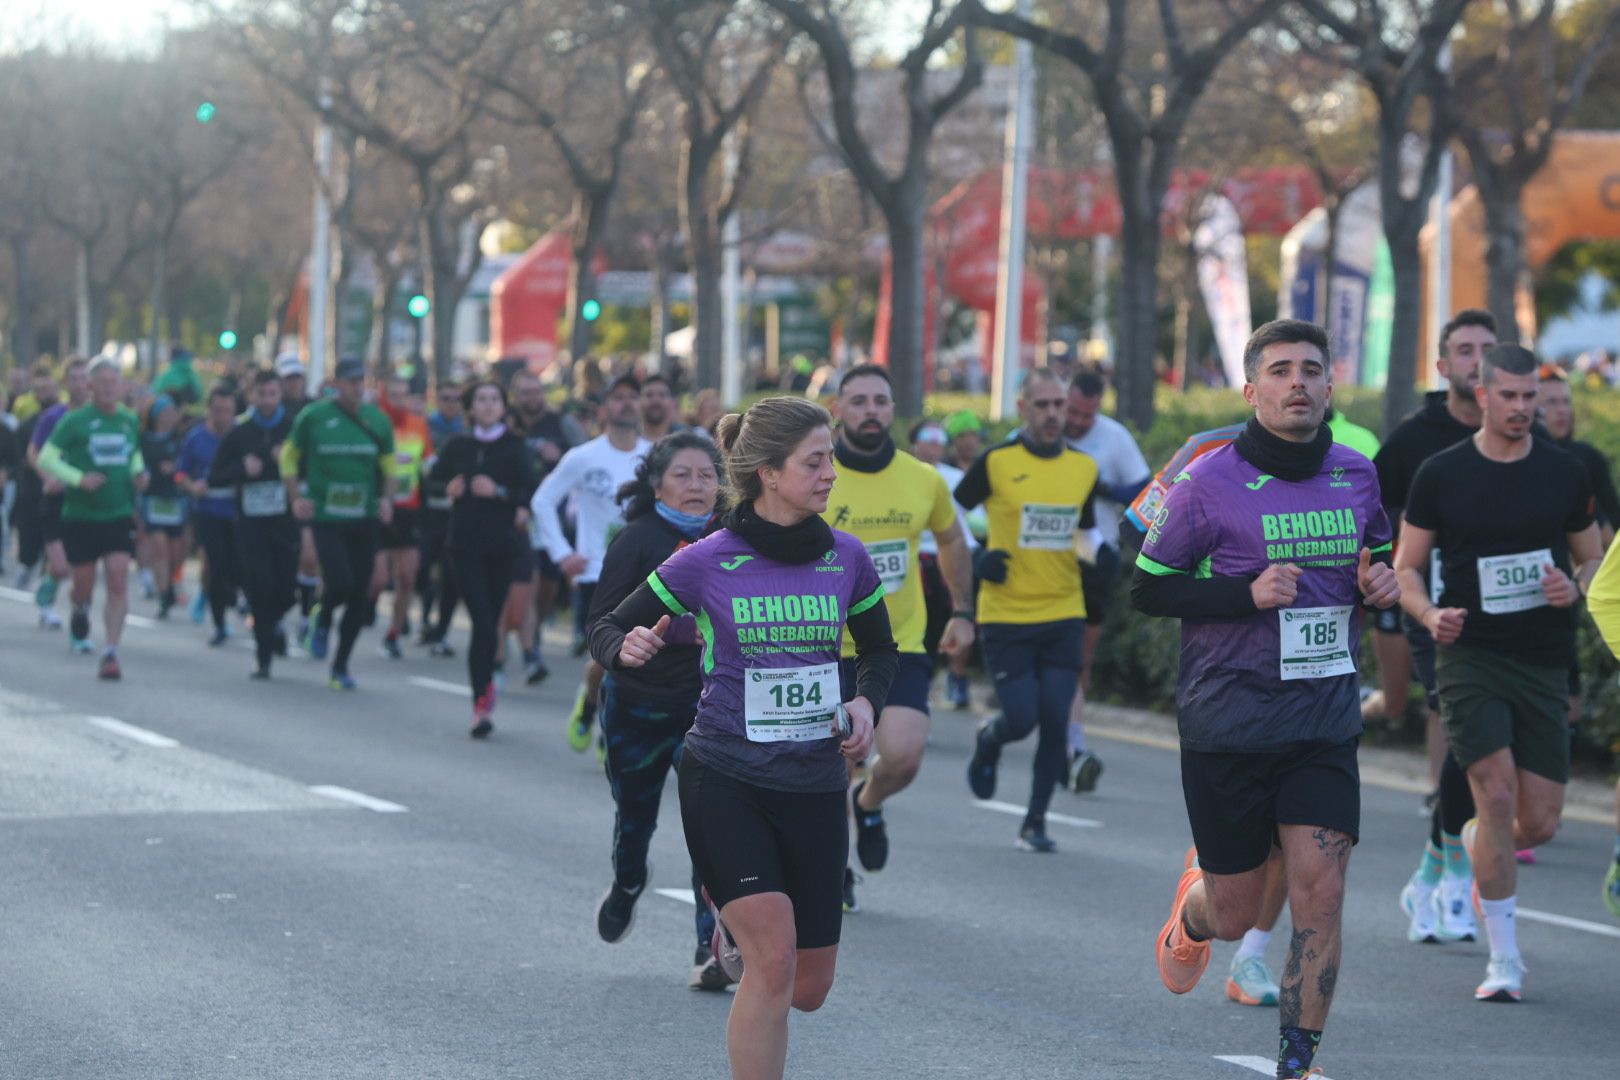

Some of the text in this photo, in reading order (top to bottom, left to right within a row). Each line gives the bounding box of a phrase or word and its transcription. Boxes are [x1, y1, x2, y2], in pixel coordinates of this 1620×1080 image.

[1261, 508, 1357, 541] BEHOBIA
[1266, 535, 1358, 560] SAN SEBASTIÁN
[1496, 563, 1540, 587] 304
[731, 594, 840, 624] BEHOBIA
[736, 627, 768, 643] SAN
[1300, 621, 1338, 646] 185
[769, 681, 822, 708] 184
